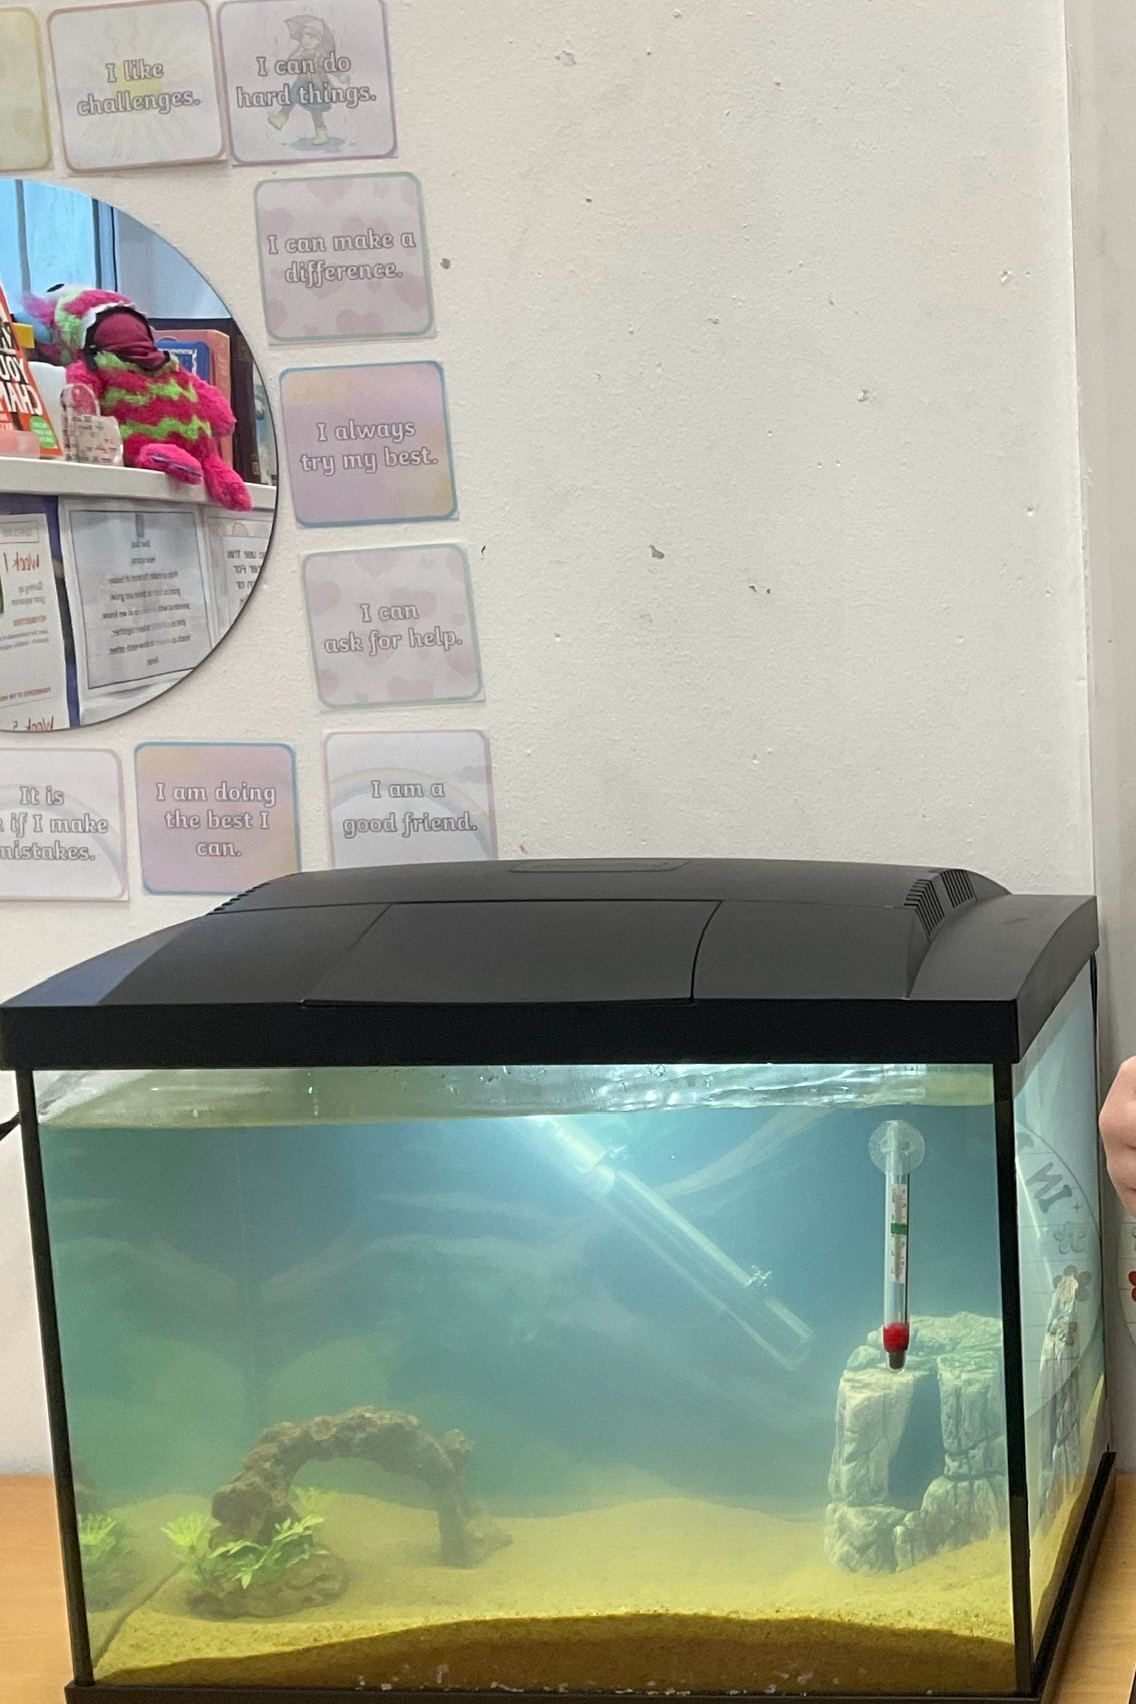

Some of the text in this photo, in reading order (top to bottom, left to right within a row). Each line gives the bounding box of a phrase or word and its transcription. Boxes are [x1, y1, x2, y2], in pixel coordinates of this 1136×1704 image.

[106, 58, 164, 83] I like
[256, 50, 351, 77] I can do
[77, 90, 200, 116] challenges.
[236, 81, 376, 108] hard things.
[267, 228, 416, 254] I can make a
[285, 260, 403, 288] difference.
[316, 419, 416, 444] I always
[300, 446, 438, 477] try my best.
[360, 603, 420, 623] I can
[324, 625, 464, 656] ask for help.
[20, 785, 65, 806] It is
[156, 782, 276, 808] I am doing
[371, 780, 446, 798] I am a
[10, 812, 28, 838] if
[32, 814, 44, 833] I
[50, 814, 109, 834] make
[164, 810, 270, 830] the best I
[343, 810, 478, 839] good friend.
[196, 841, 242, 858] can.
